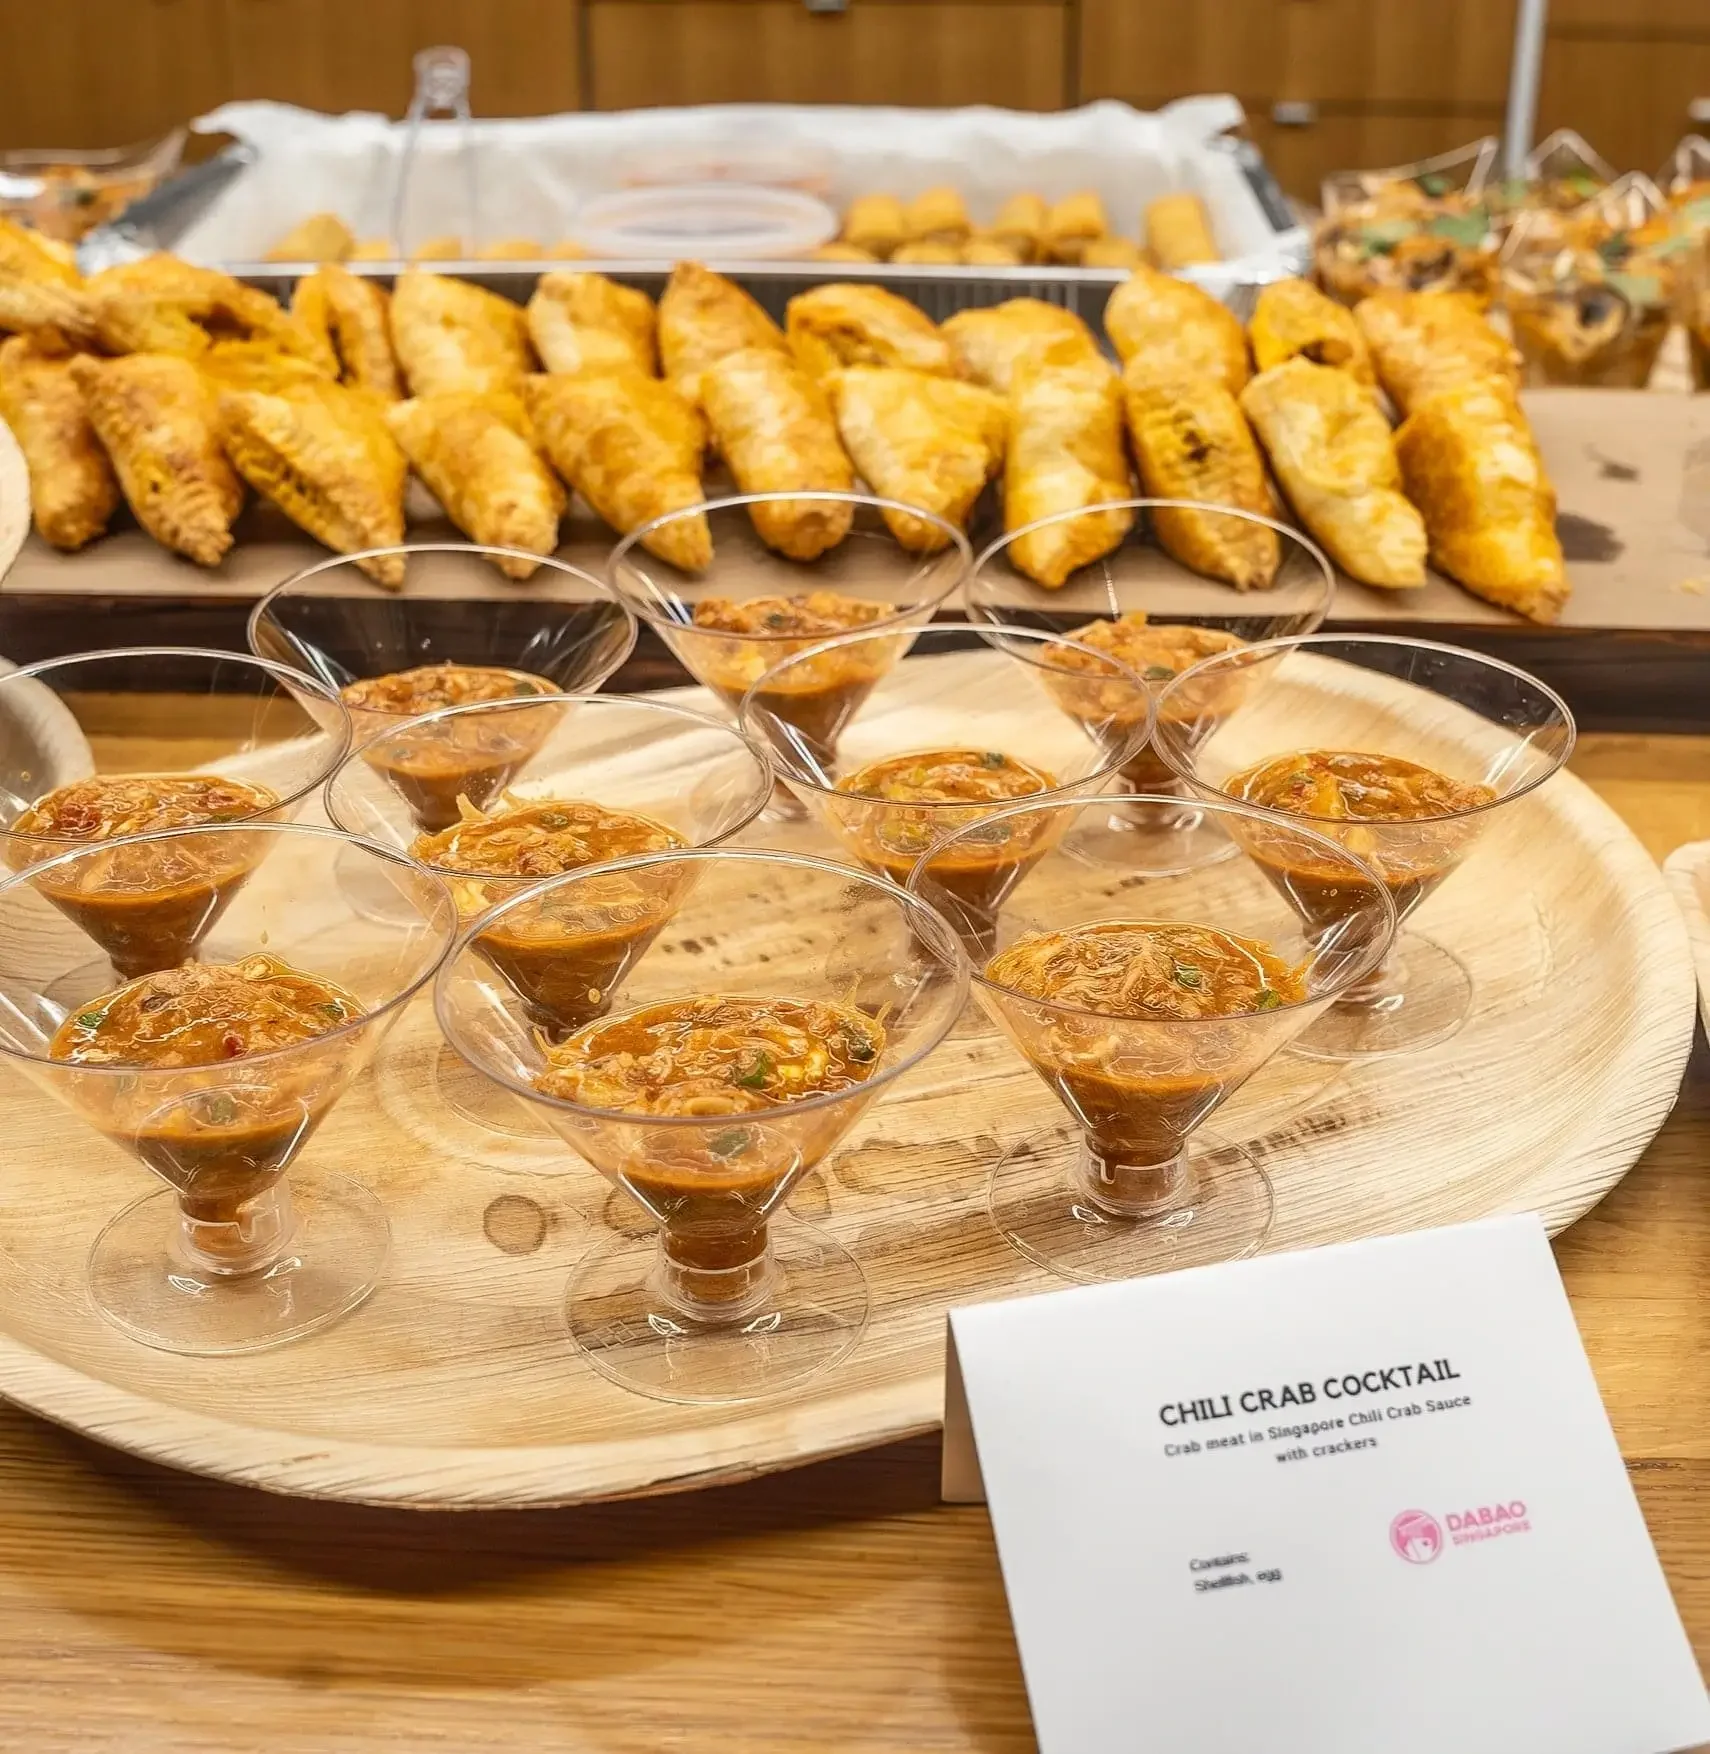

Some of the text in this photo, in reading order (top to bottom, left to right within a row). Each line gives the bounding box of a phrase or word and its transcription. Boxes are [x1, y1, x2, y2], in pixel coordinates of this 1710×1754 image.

[1160, 1358, 1461, 1426] CHILI CRAB COCKTAIL
[1165, 1394, 1472, 1457] Crab meat in Singapore Chili Crab Sauce
[1275, 1436, 1378, 1463] with crackers
[1445, 1500, 1527, 1532] DABAO
